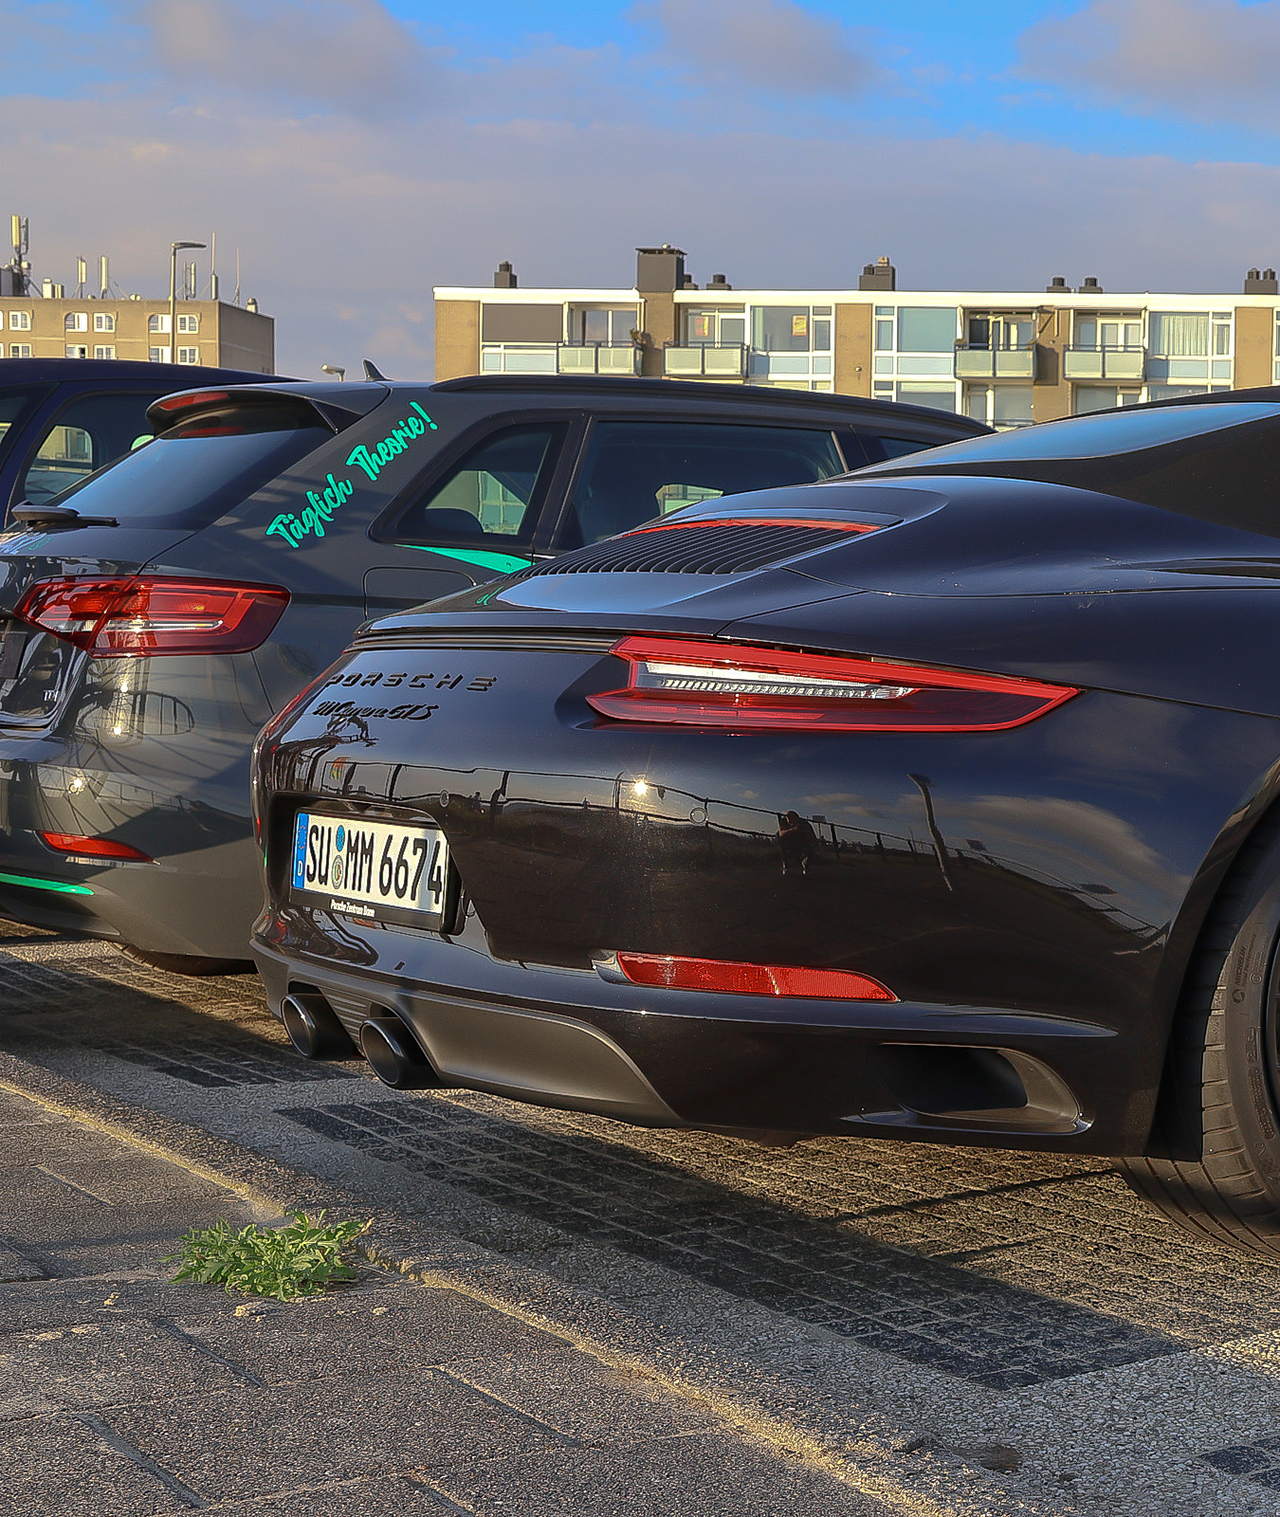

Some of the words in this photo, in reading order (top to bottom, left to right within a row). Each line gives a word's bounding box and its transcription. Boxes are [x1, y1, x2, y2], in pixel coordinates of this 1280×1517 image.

[266, 473, 353, 548] Täglich
[346, 401, 438, 481] Theorie!
[325, 672, 497, 692] PORSCHE
[386, 703, 439, 721] GTS
[297, 860, 303, 877] D
[306, 824, 332, 886] SU
[344, 829, 375, 894] MM
[379, 834, 442, 905] 6674
